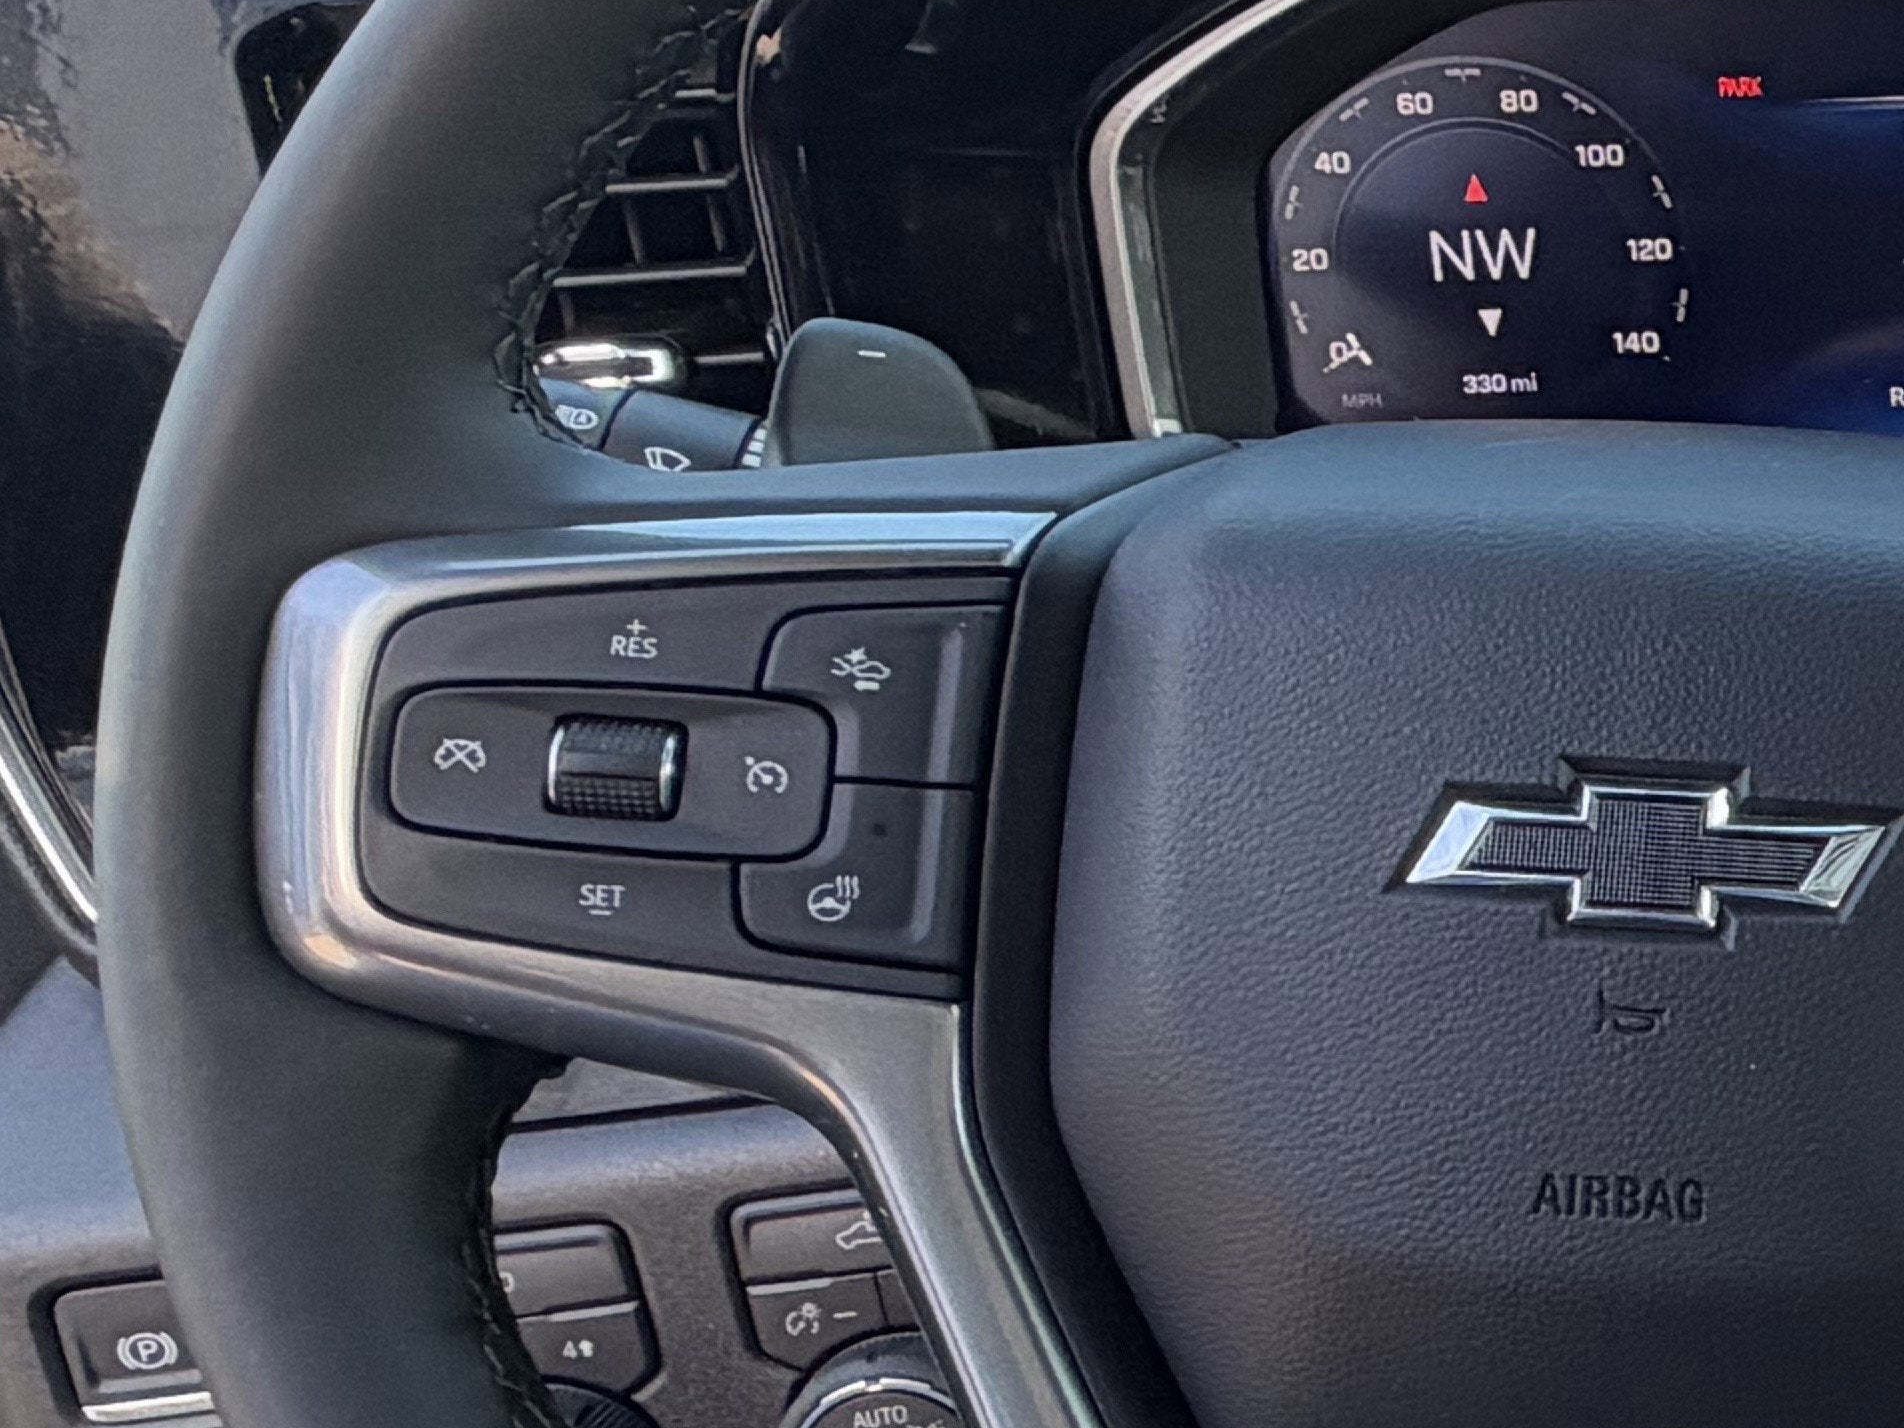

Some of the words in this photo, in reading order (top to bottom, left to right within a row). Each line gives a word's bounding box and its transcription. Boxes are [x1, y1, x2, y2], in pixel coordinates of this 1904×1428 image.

[1718, 76, 1763, 99] PARK
[1396, 91, 1434, 117] 60
[1499, 89, 1539, 114] 80
[1314, 150, 1352, 176] 40
[1574, 143, 1626, 169] 100
[1291, 247, 1329, 272] 20
[1427, 227, 1537, 283] NW
[1626, 237, 1673, 263] 120
[1611, 331, 1661, 355] 140
[1462, 373, 1508, 396] 330
[1510, 370, 1539, 394] mi
[1341, 391, 1384, 410] MPH
[609, 635, 659, 660] RES
[578, 883, 626, 908] SET
[1530, 1171, 1709, 1224] AIRBAG
